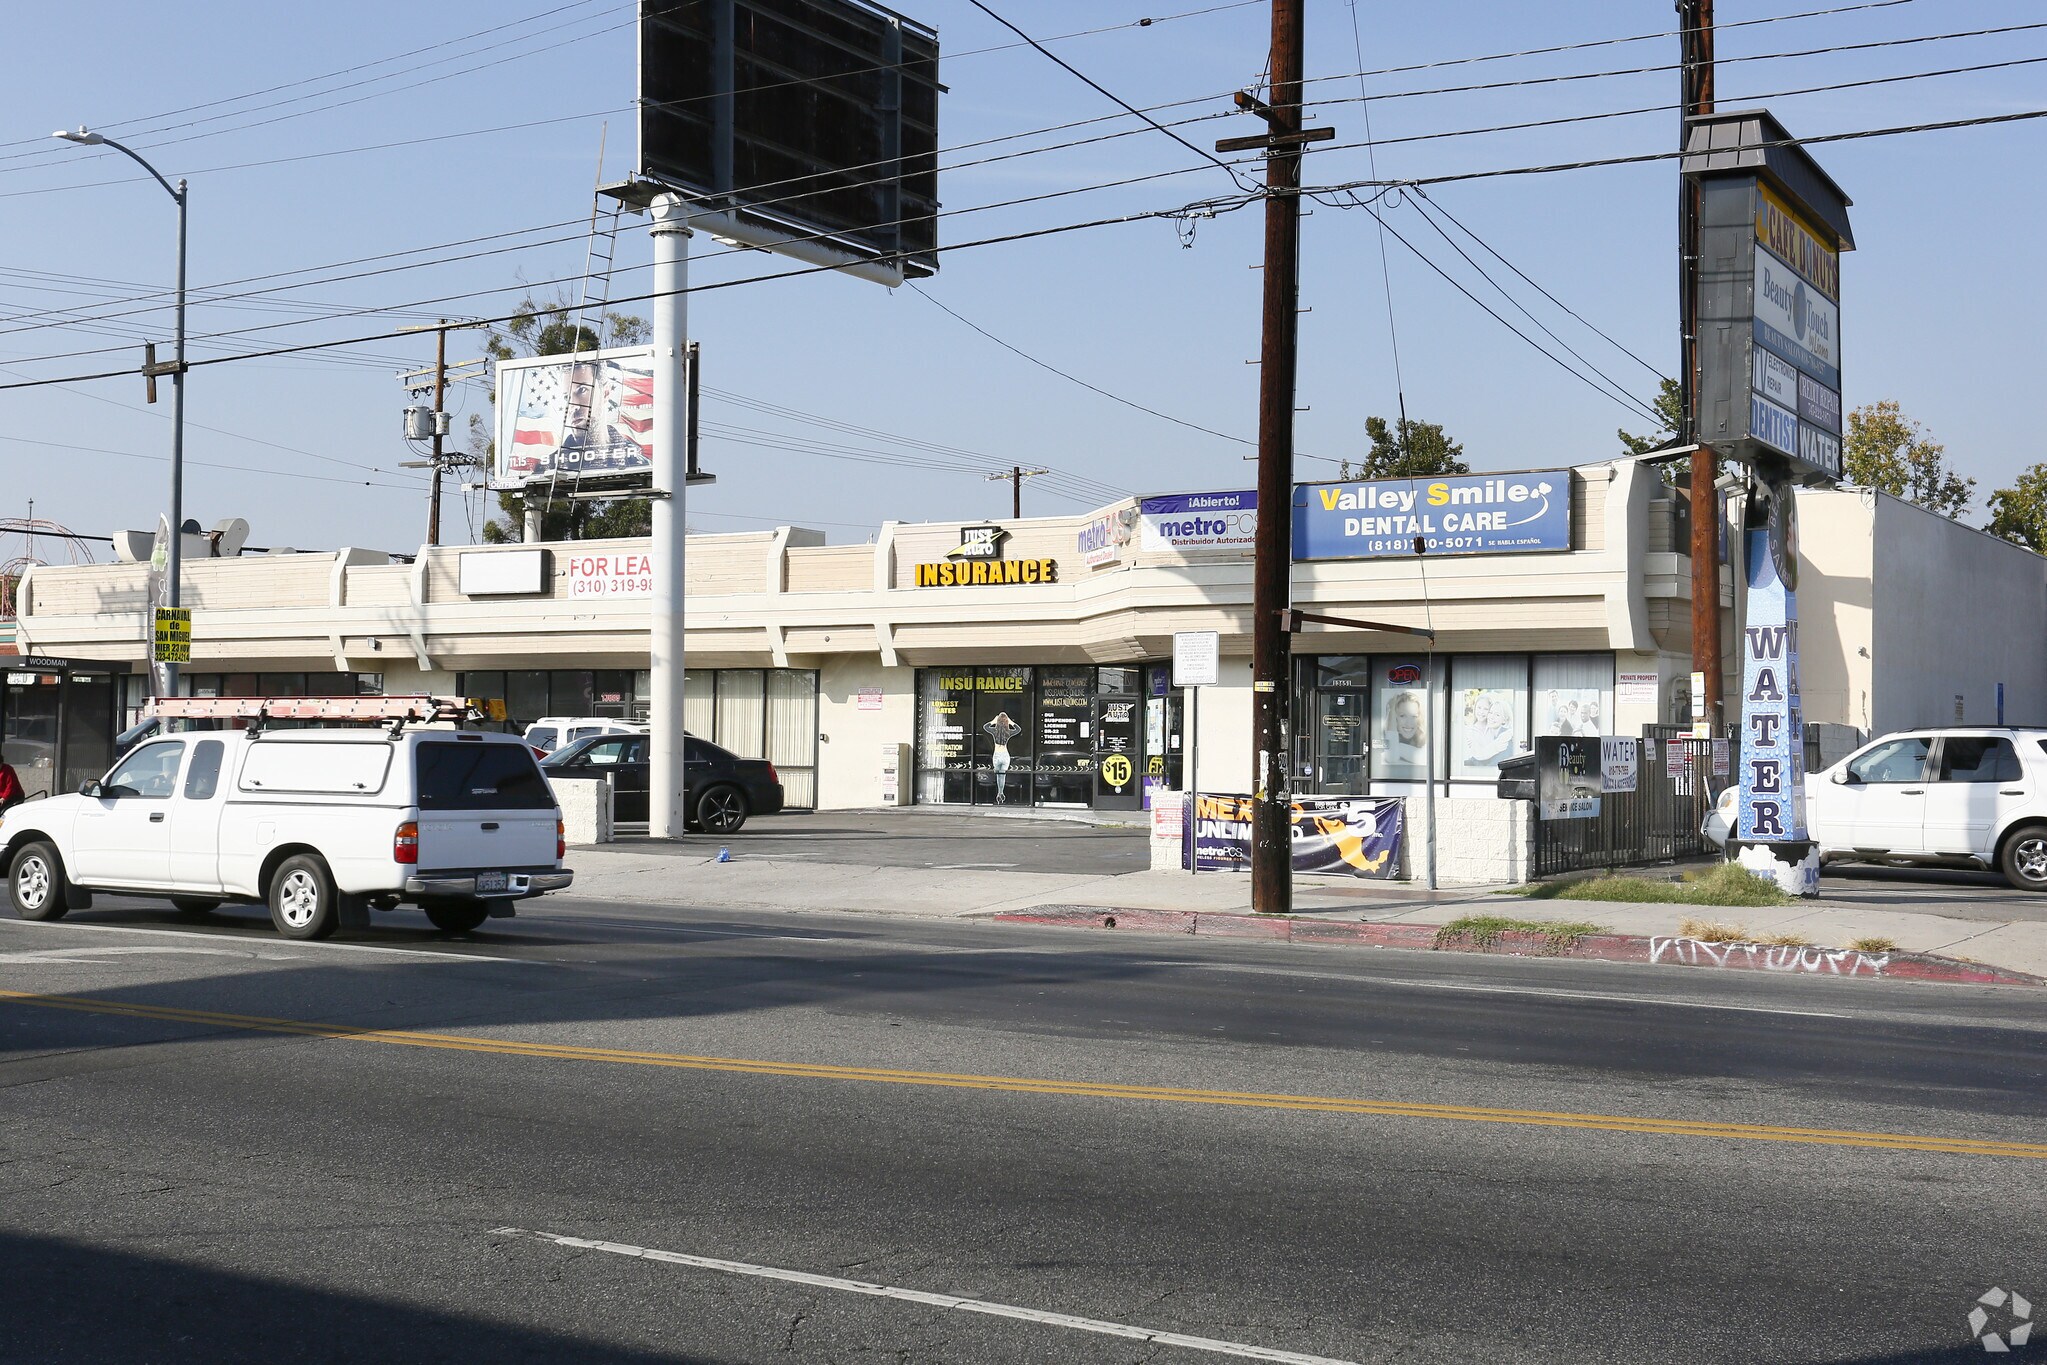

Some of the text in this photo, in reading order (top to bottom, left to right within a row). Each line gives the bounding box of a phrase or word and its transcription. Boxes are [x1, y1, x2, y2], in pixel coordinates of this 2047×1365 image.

[1768, 205, 1838, 299] CAFE DONUTS
[1763, 267, 1829, 341] Beauty Touch
[1752, 342, 1769, 395] TV
[1768, 354, 1796, 382] ELECTRONICS
[1767, 375, 1782, 395] REPAIR
[1799, 375, 1840, 416] CREDIT REPAIR
[1751, 398, 1797, 454] DENTIST
[540, 448, 638, 467] SHOOTER
[1800, 424, 1840, 473] WATER
[489, 480, 527, 489] OUTFRONT
[1188, 496, 1240, 508] ¡Abierto!
[1318, 480, 1529, 511] Valley Smile
[1344, 511, 1507, 537] DENTAL CARE
[964, 529, 994, 543] JUST
[1172, 538, 1214, 546] Distribuidor
[1516, 538, 1541, 546] ESPAÑOL
[963, 543, 995, 557] AUTO
[570, 556, 652, 577] FOR LEA
[915, 558, 1052, 587] INSURANCE
[573, 580, 606, 596] (310)
[156, 609, 191, 621] CARNAVAL
[169, 621, 180, 630] de
[155, 631, 190, 642] SAN MIGUEL
[155, 643, 170, 652] MIER
[171, 643, 180, 653] 23
[29, 658, 68, 667] WOODMAN
[940, 676, 1023, 691] INSURANCE
[1389, 669, 1419, 682] OPEN
[932, 700, 959, 708] LOWEST
[1745, 626, 1787, 836] WATER
[1786, 619, 1805, 830] WATER
[1559, 743, 1587, 768] Beauty
[1603, 741, 1636, 762] WATER
[1105, 761, 1127, 780] $15
[1559, 803, 1577, 812] SERICE
[1578, 802, 1593, 811] SALON
[1803, 867, 1819, 885] IC
